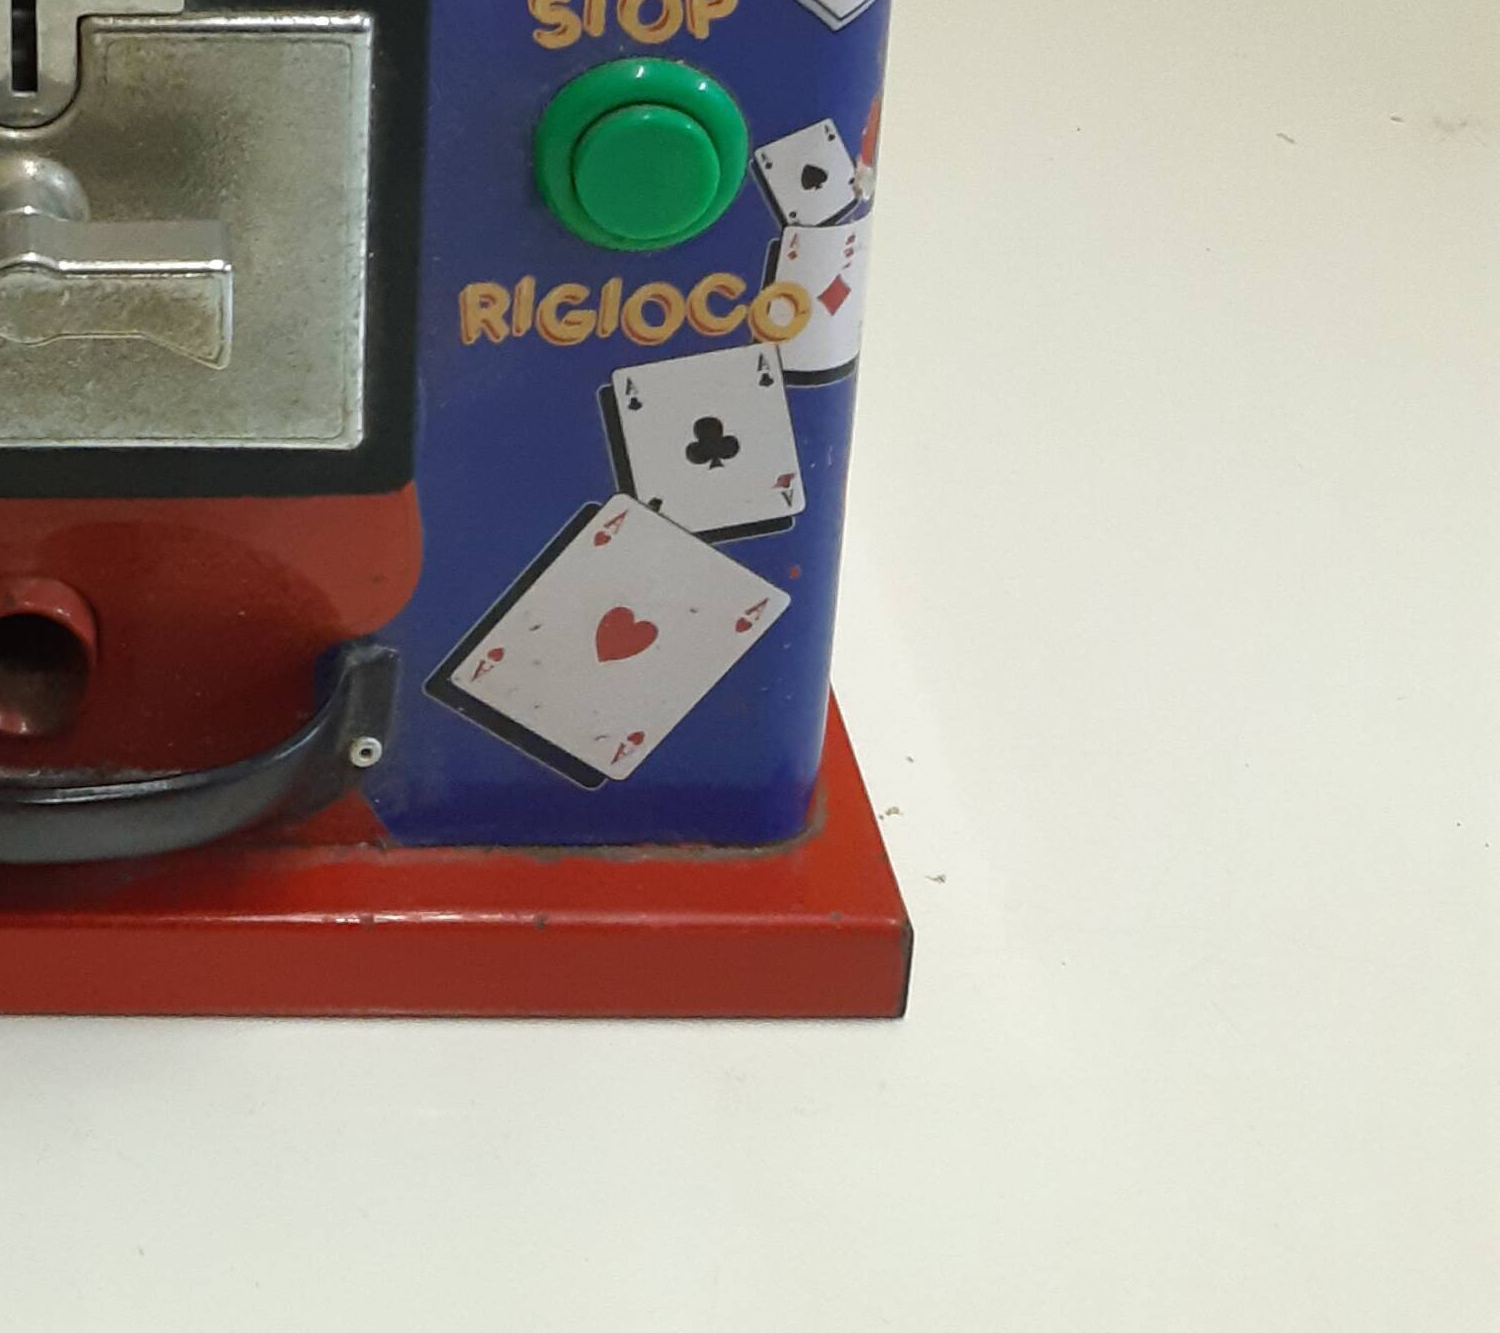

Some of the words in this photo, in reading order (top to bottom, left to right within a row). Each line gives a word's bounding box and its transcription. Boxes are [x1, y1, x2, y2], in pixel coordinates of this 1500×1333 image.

[459, 272, 812, 347] RIGIOCO
[603, 509, 629, 535] A
[744, 597, 770, 622] A
